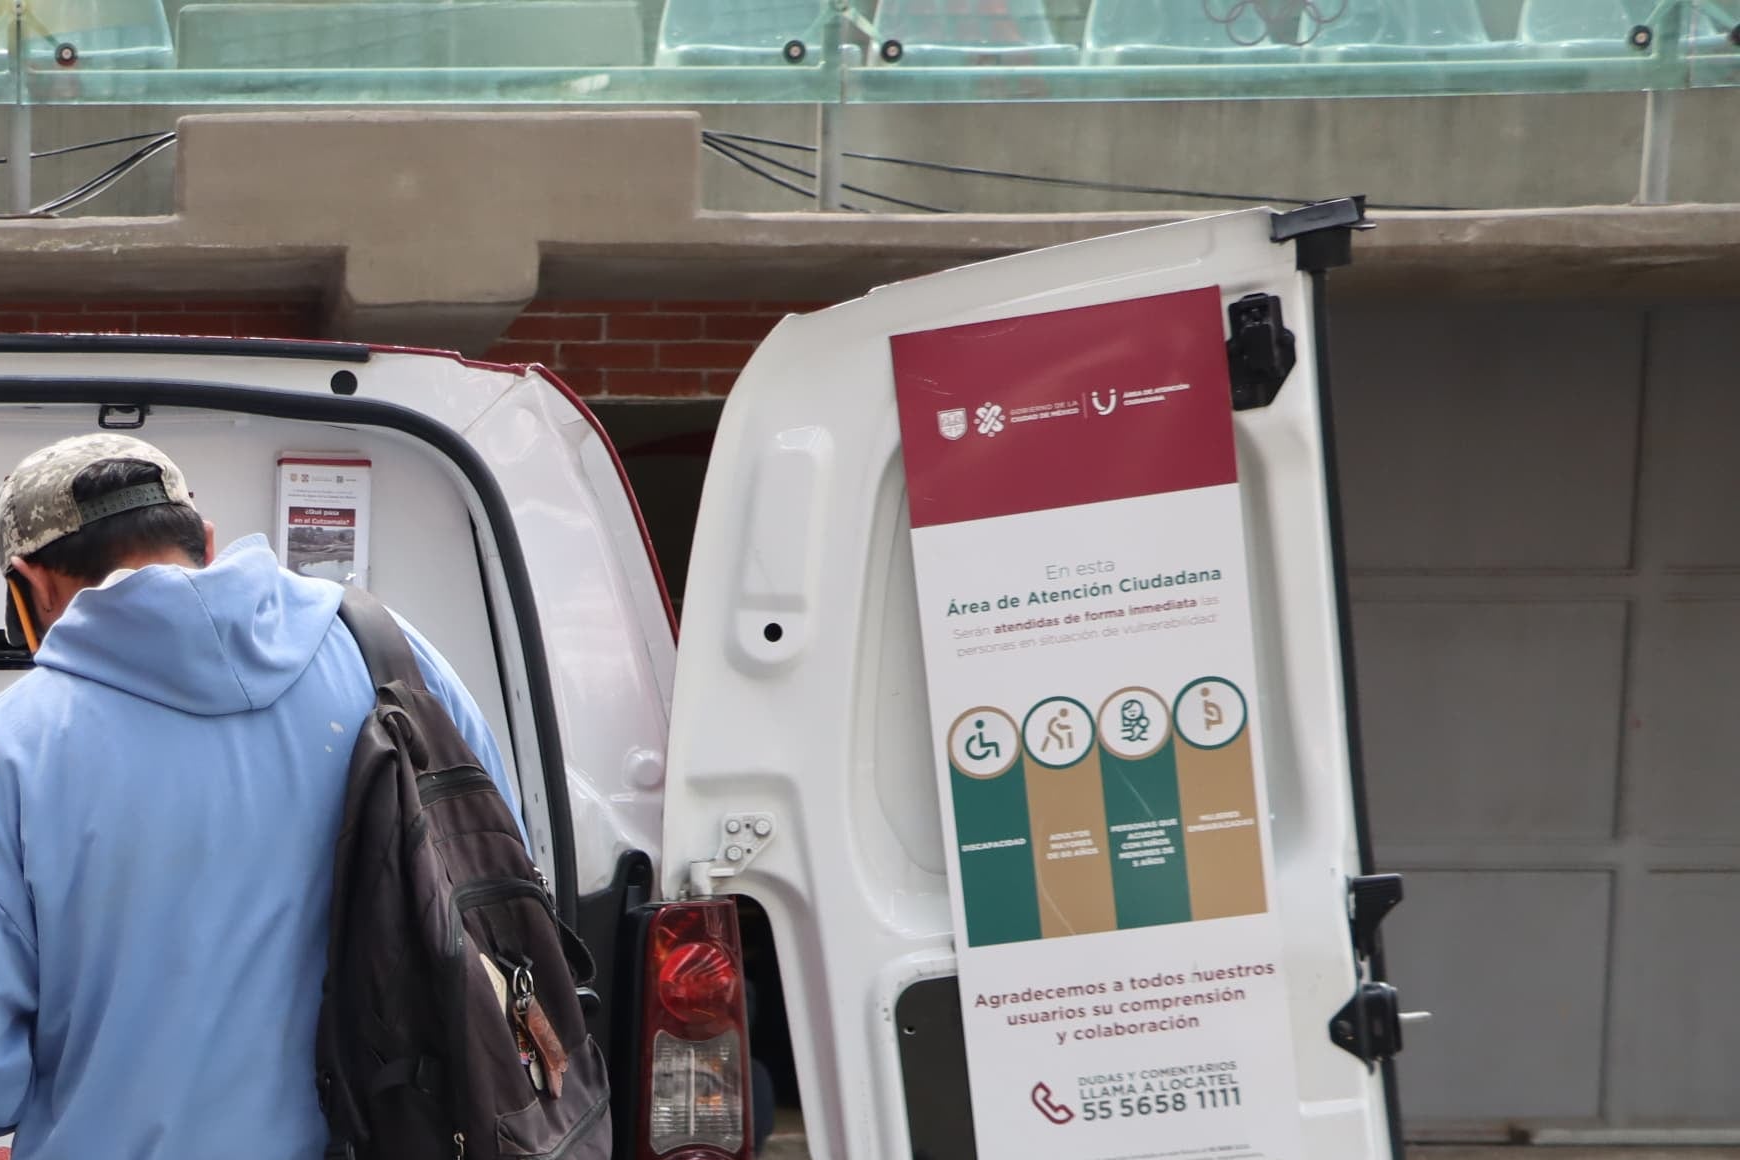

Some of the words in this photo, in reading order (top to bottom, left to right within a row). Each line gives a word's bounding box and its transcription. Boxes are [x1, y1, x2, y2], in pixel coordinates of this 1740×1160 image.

[1045, 564, 1070, 580] En
[1076, 560, 1116, 576] esta
[947, 598, 991, 617] Área
[997, 594, 1021, 610] de
[1027, 582, 1113, 606] Atención
[1119, 569, 1222, 593] Ciudadana
[994, 617, 1060, 634] atendidas
[1063, 613, 1081, 625] de
[1084, 608, 1125, 621] forma
[1128, 597, 1198, 615] inmediata
[974, 982, 1107, 1008] Agradecemos
[1113, 980, 1124, 993] a
[1129, 972, 1185, 990] todos
[1191, 962, 1275, 983] nuestros
[1007, 1006, 1087, 1026] usuarios
[1092, 1003, 1113, 1017] su
[1120, 987, 1246, 1011] comprensión
[1056, 1031, 1067, 1045] y
[1074, 1015, 1200, 1040] colaboración
[1078, 1072, 1124, 1087] DUDAS
[1128, 1071, 1137, 1082] Y
[1140, 1061, 1238, 1080] COMENTARIOS
[1079, 1083, 1137, 1100] LLAMA
[1143, 1081, 1155, 1093] A
[1160, 1073, 1239, 1092] LOCATEL
[1082, 1100, 1113, 1122] 55
[1120, 1092, 1187, 1118] 5658
[1195, 1086, 1242, 1110] 1111
